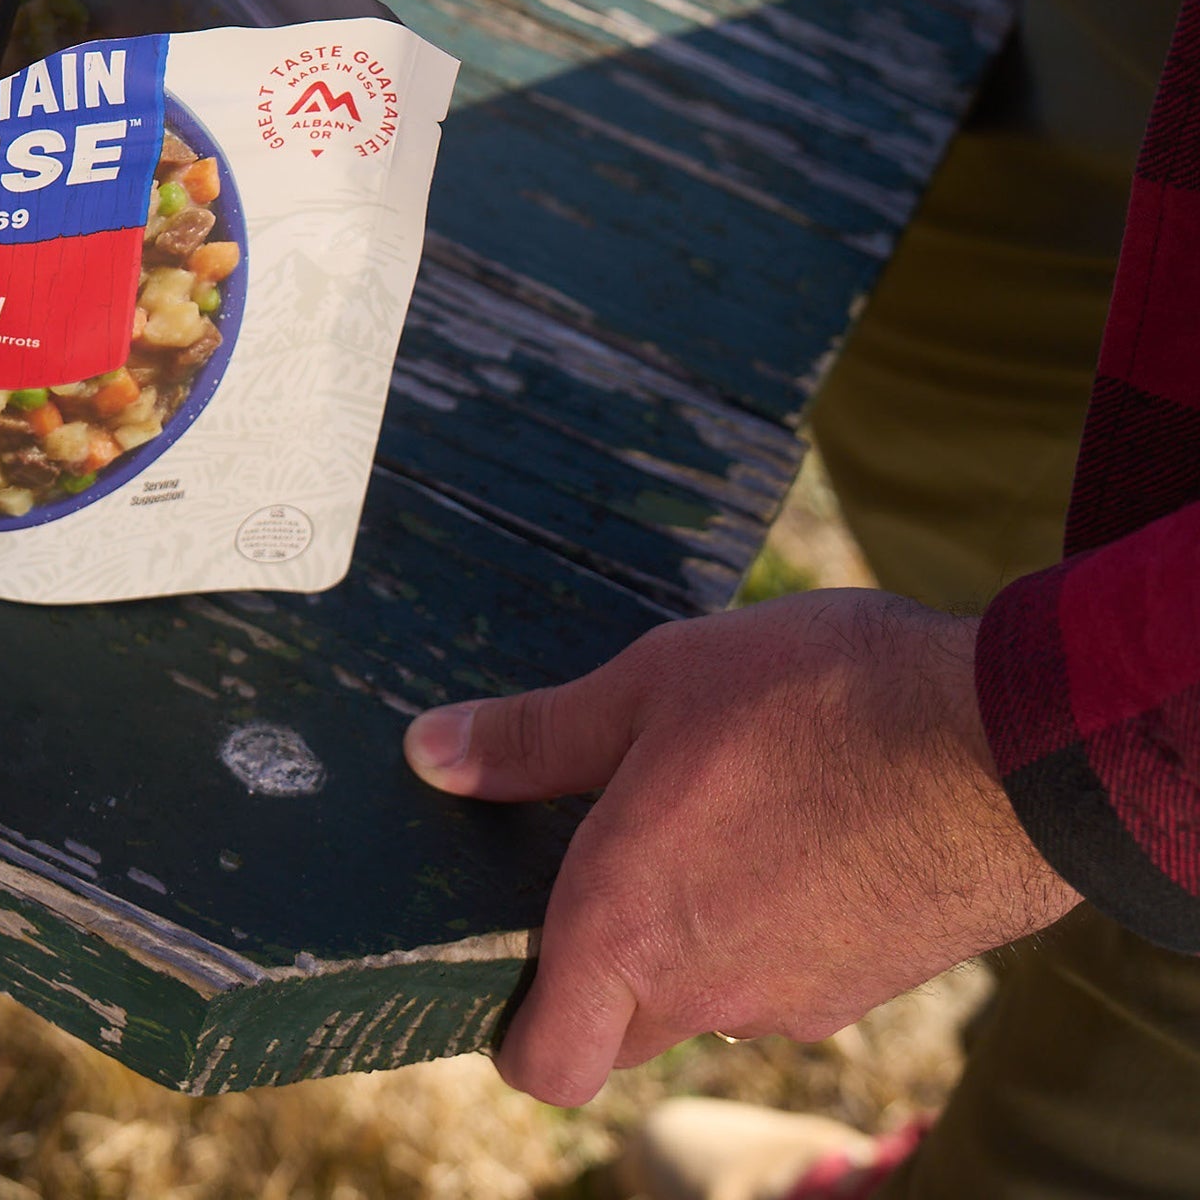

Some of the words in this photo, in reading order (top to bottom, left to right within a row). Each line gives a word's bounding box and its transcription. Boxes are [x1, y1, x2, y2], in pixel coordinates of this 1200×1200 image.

[270, 45, 343, 79] TASTE
[287, 62, 331, 88] MADE
[336, 62, 353, 73] IN
[356, 72, 377, 100] USA
[257, 85, 285, 149] GREAT
[353, 50, 399, 158] GUARANTEE
[291, 119, 355, 133] ALBANY
[309, 130, 332, 140] OR
